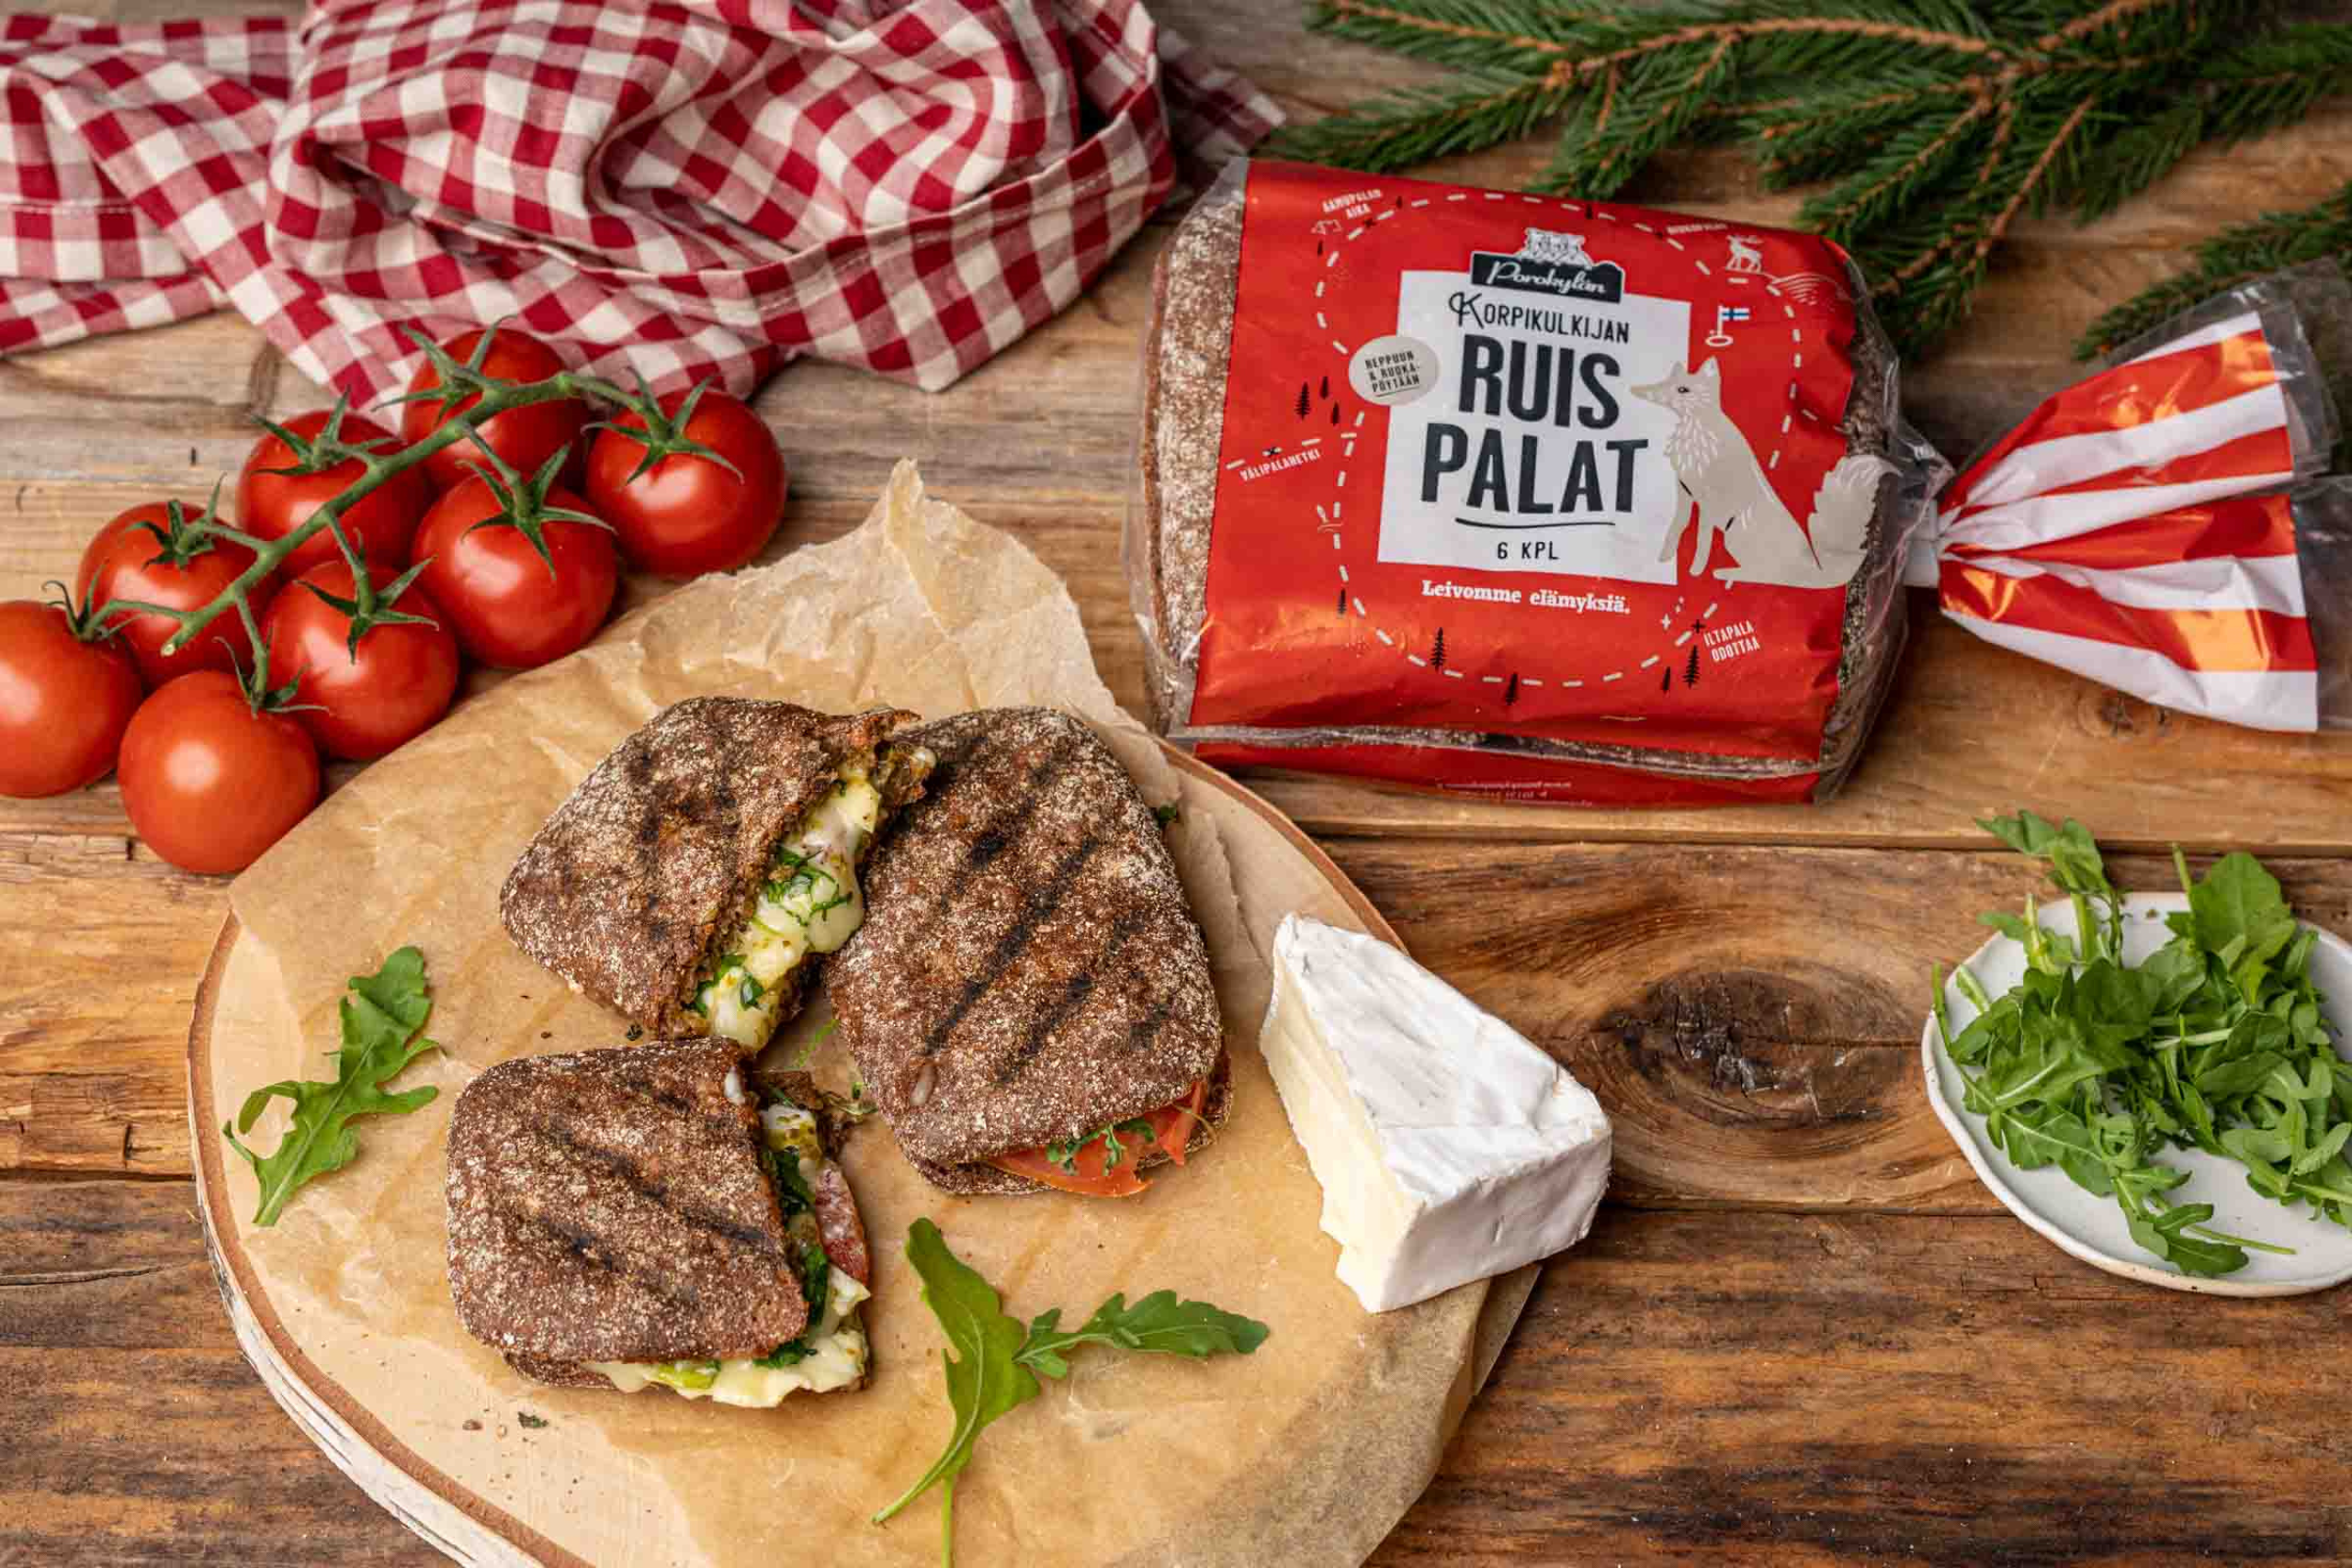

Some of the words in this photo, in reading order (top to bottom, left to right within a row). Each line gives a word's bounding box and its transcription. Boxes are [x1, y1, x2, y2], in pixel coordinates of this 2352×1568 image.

[1448, 291, 1630, 344] KORPIKULKIJAN
[1458, 333, 1621, 430] RUIS
[1421, 423, 1649, 514] PALAT
[1497, 541, 1509, 560] 6
[1521, 540, 1560, 560] KPL
[1421, 579, 1522, 604] Leivomme
[1529, 588, 1631, 615] elämyksiä.
[1702, 619, 1755, 648] ILTAPALA
[1711, 636, 1761, 664] ODOTTAA
